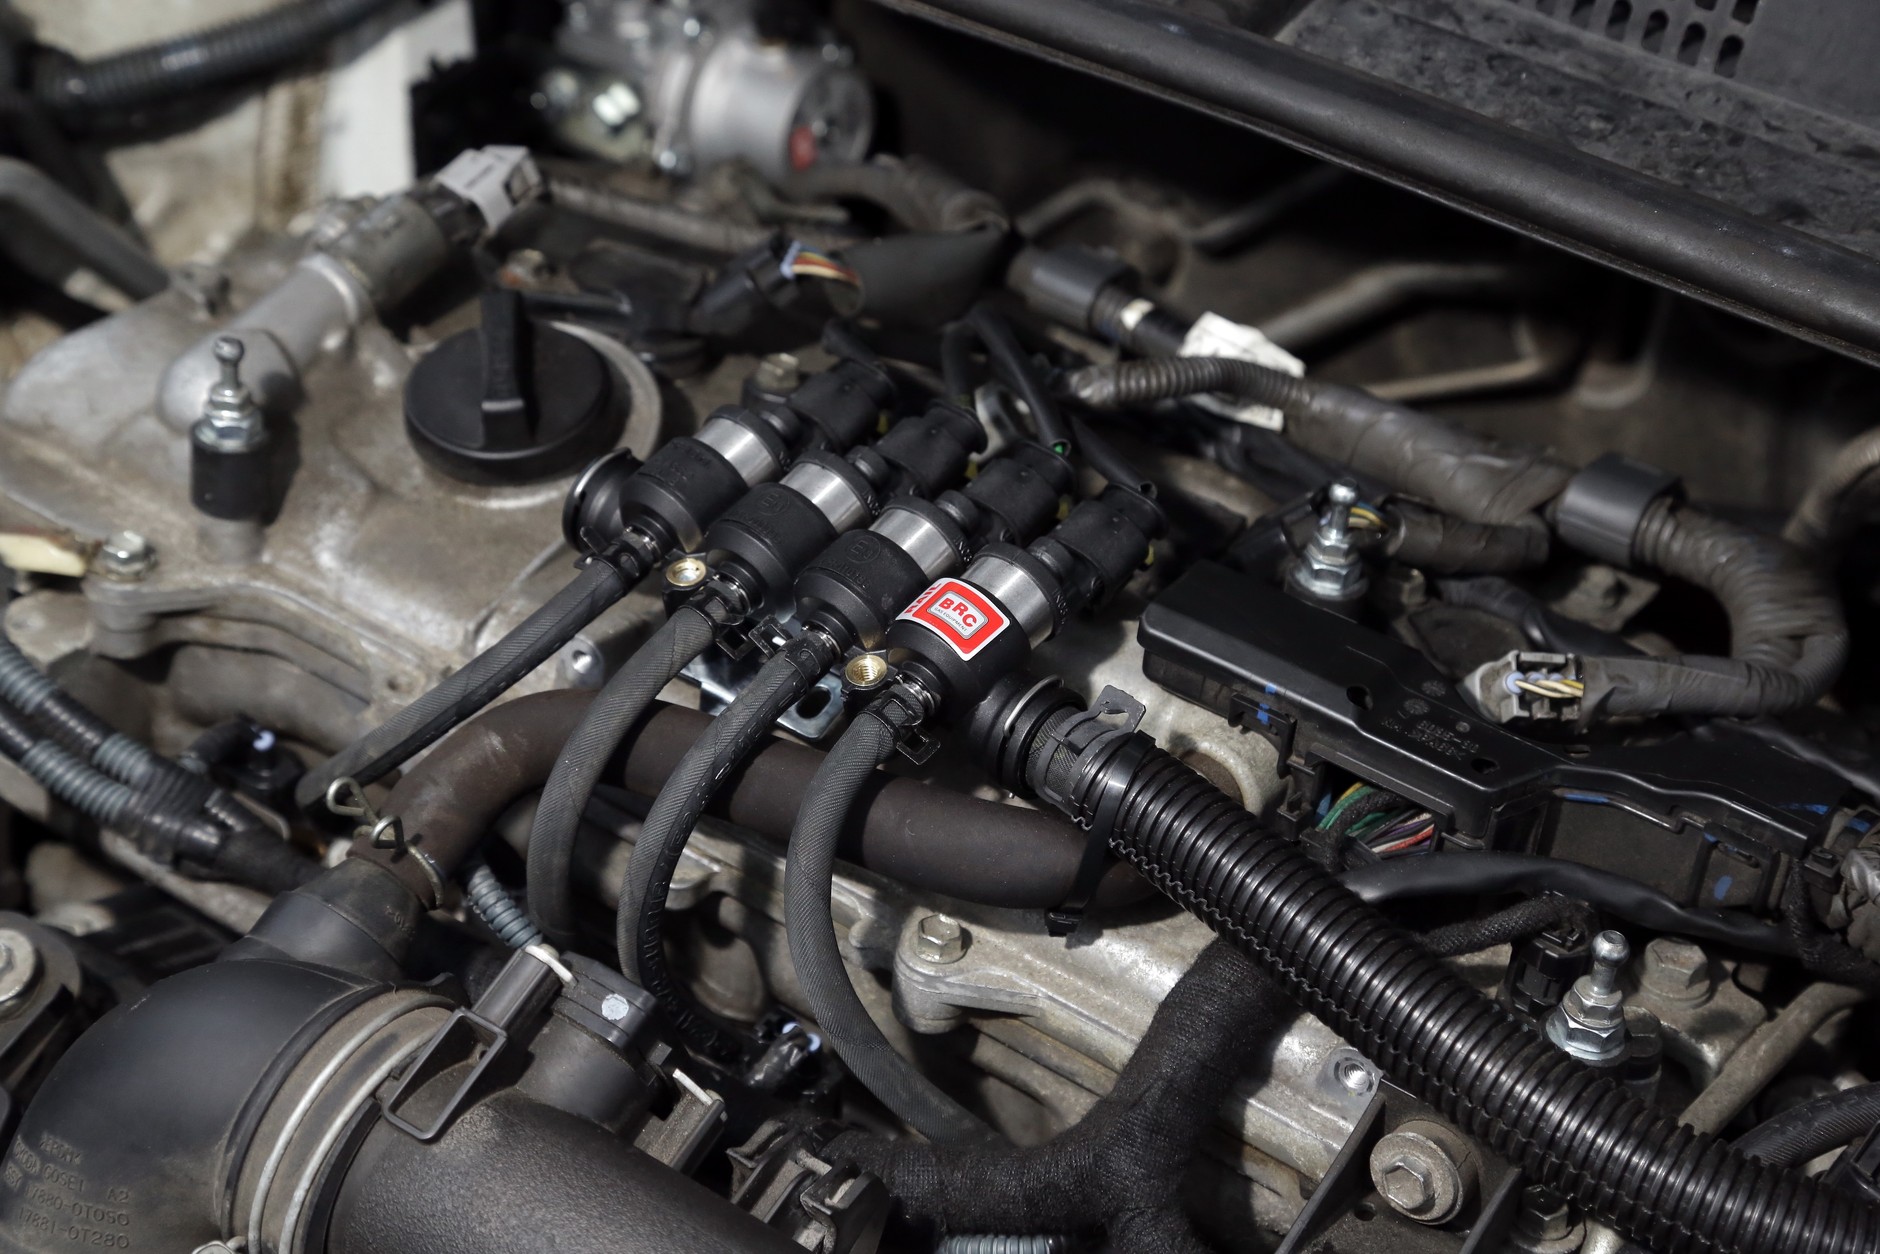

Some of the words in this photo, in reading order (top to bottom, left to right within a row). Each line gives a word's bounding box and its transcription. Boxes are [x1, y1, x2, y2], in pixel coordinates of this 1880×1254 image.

[905, 583, 943, 615] RAIL
[938, 597, 977, 628] BRC
[943, 612, 968, 632] EQUIPMENT
